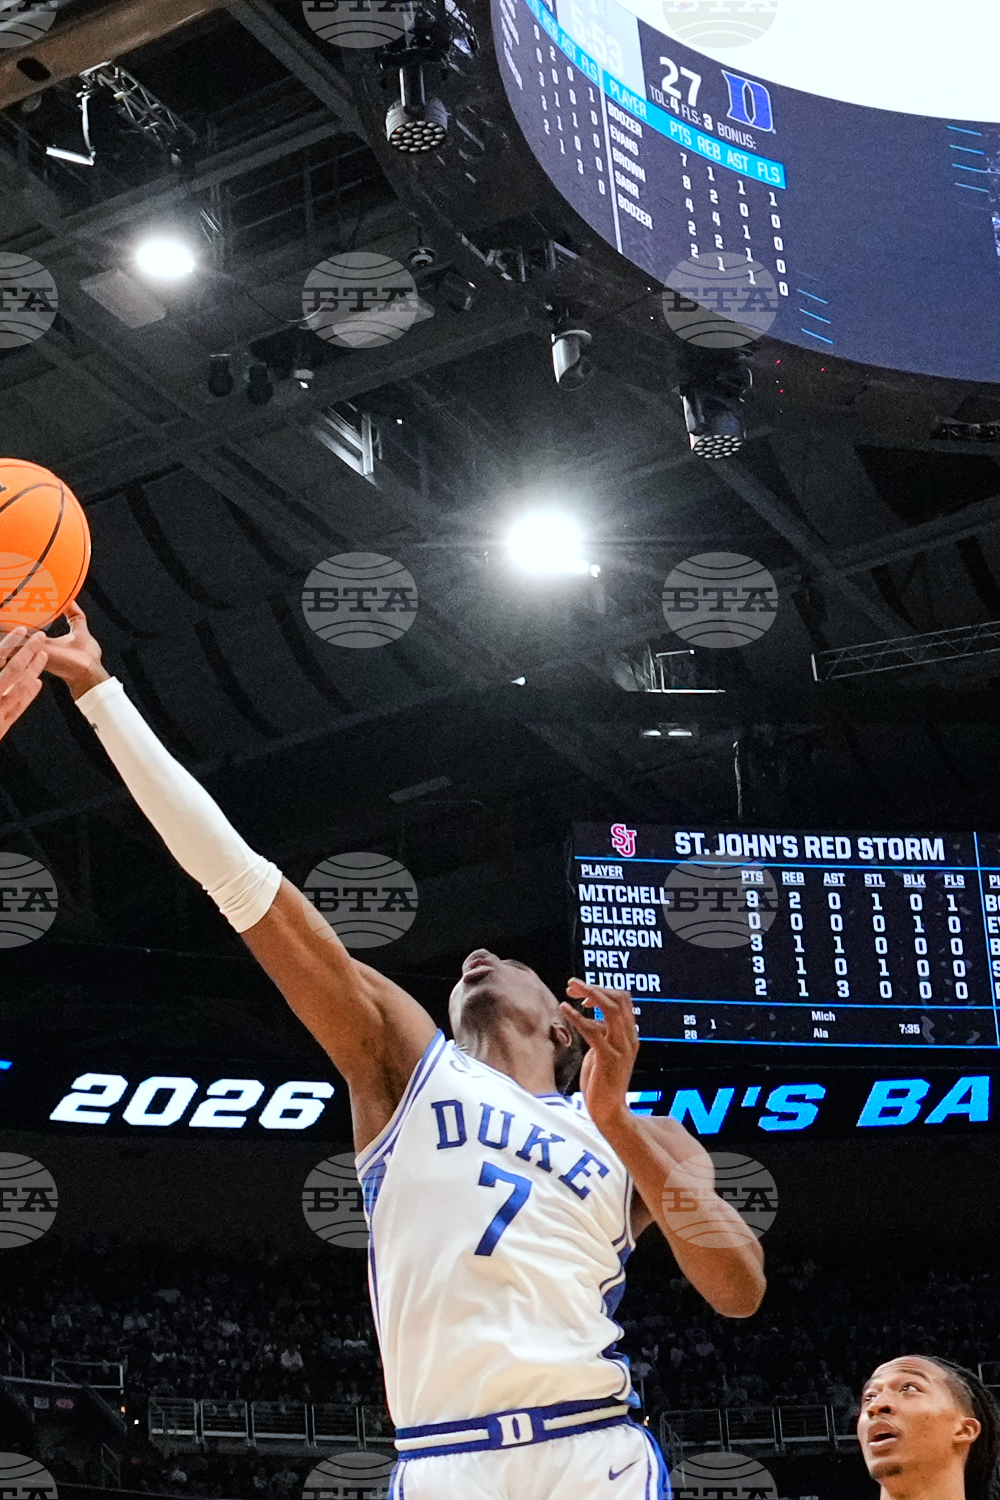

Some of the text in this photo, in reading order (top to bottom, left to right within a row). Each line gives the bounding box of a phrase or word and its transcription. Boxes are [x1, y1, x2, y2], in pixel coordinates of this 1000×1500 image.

[659, 56, 702, 107] 27
[609, 80, 781, 184] PLAYER PTS REB AST FLS
[670, 97, 680, 114] 4
[681, 104, 701, 126] FLS:
[703, 113, 713, 131] 3
[717, 122, 757, 150] BONUS:
[607, 101, 778, 207] BOOZER 7 1 1 1
[609, 124, 781, 229] EVANS 8 2 0 0
[612, 146, 783, 251] BROWN 4 4 1 0
[615, 170, 786, 274] SARR 2 2 1 0
[617, 193, 789, 297] BOOZER 2 1 1 0
[674, 831, 946, 861] ST. JOHN'S RED STORM
[578, 884, 958, 912] MITCHELL 9 2 0 1 0 1
[581, 864, 965, 886] PLAYER PTS REB AST STL BLK FLS
[580, 906, 961, 934] SELLERS 0 0 0 0 1 0
[582, 928, 964, 956] JACKSON 3 1 1 0 0 0
[583, 950, 966, 977] PREY 3 1 0 1 0 0
[755, 978, 767, 995] 2
[797, 979, 809, 997] 1
[836, 980, 850, 998] 3
[879, 981, 892, 999] 0
[919, 981, 932, 999] 0
[955, 982, 968, 999] 0
[811, 1010, 836, 1022] Mich
[899, 1024, 920, 1035] 7:35
[49, 1073, 334, 1129] 2026
[855, 1075, 990, 1128] BA
[431, 1099, 610, 1200] DUKE
[474, 1161, 533, 1257] 7
[496, 1413, 534, 1446] D
